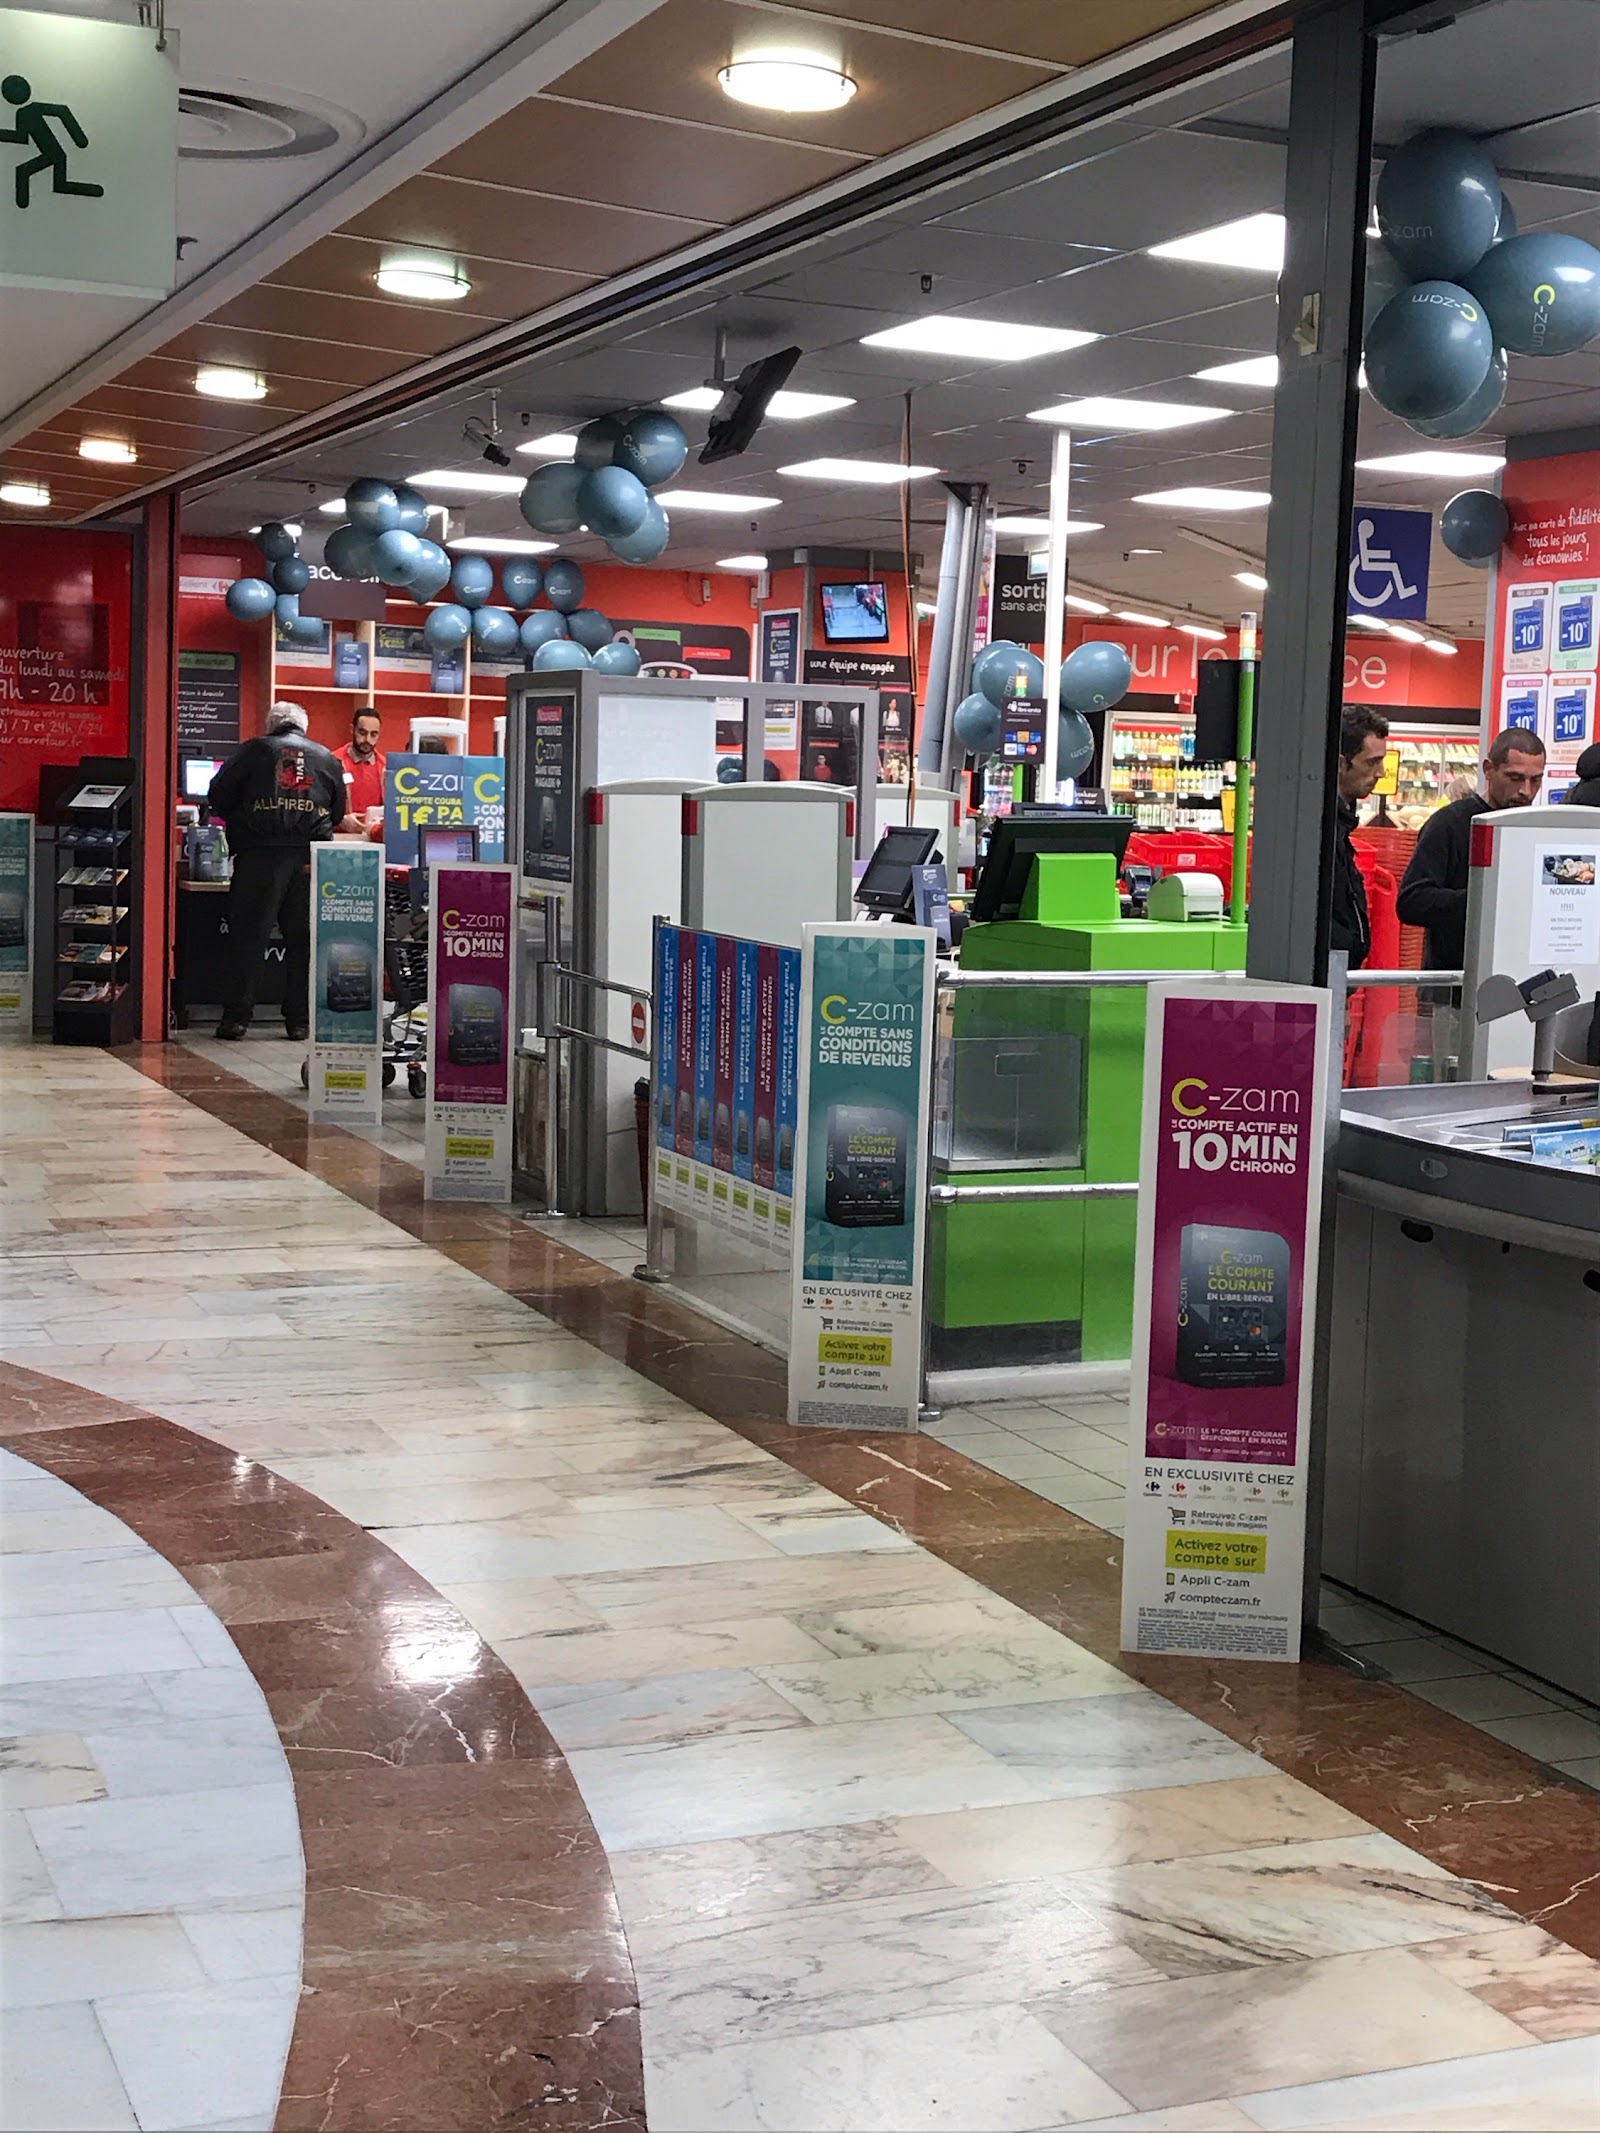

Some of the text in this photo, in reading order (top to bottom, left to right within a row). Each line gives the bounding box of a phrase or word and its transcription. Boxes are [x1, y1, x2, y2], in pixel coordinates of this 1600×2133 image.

[1411, 292, 1478, 322] C-zam
[1531, 284, 1556, 347] C-zam
[1527, 532, 1587, 551] tous les jours
[1522, 554, 1534, 567] des
[1536, 551, 1583, 566] économies
[1001, 581, 1048, 600] sorti
[1001, 601, 1026, 612] sans
[19, 661, 53, 678] lundi
[58, 668, 76, 679] au
[810, 658, 895, 676] une équipe engagée
[48, 682, 76, 703] 20
[84, 682, 98, 704] h
[253, 797, 314, 812] ALLFIRED
[400, 796, 433, 804] COMPTE
[321, 881, 375, 899] C-zam
[1549, 887, 1587, 896] NOUVEAU
[321, 905, 375, 914] CONDITIONS
[321, 913, 333, 922] DE
[442, 910, 505, 930] C-zam
[447, 930, 473, 938] COMPTE
[443, 936, 505, 958] 10 MIN
[472, 950, 505, 959] CHRONO
[820, 994, 915, 1024] C-zam
[827, 1025, 877, 1038] COMPTE
[879, 1027, 914, 1040] SANS
[819, 1037, 913, 1054] CONDITIONS
[819, 1051, 912, 1068] DE REVENUS
[1171, 1078, 1299, 1117] C-zam
[1178, 1119, 1235, 1131] COMPTE
[1236, 1122, 1277, 1134] ACTIF
[1279, 1124, 1298, 1135] EN
[861, 1136, 897, 1146] COMPTE
[847, 1145, 897, 1156] COURANT
[1172, 1131, 1298, 1172] 10 MIN
[1230, 1160, 1296, 1175] CHRONO
[1221, 1248, 1264, 1265] C-zam
[1208, 1265, 1275, 1280] LE COMPTE
[802, 1286, 913, 1300] EN EXCLUSIVITÉ CHEZ
[1208, 1278, 1275, 1293] COURANT
[1178, 1277, 1189, 1327] C-zam
[1206, 1293, 1218, 1301] EN
[825, 1340, 887, 1351] Activez votre
[825, 1350, 886, 1362] compte sur
[829, 1367, 881, 1378] Appli C-zam
[1154, 1422, 1196, 1436] C-zam
[1220, 1429, 1251, 1437] COMPTE
[1251, 1430, 1288, 1439] COURANT
[1144, 1467, 1295, 1486] EN EXCLUSIVITÉ CHEZ
[1191, 1510, 1268, 1522] Retrouvez C-zam
[1175, 1538, 1258, 1554] Activez votre
[1174, 1552, 1257, 1568] compte sur
[1180, 1574, 1251, 1588] Appli C-zam
[1179, 1593, 1262, 1607] compteczam.fr
